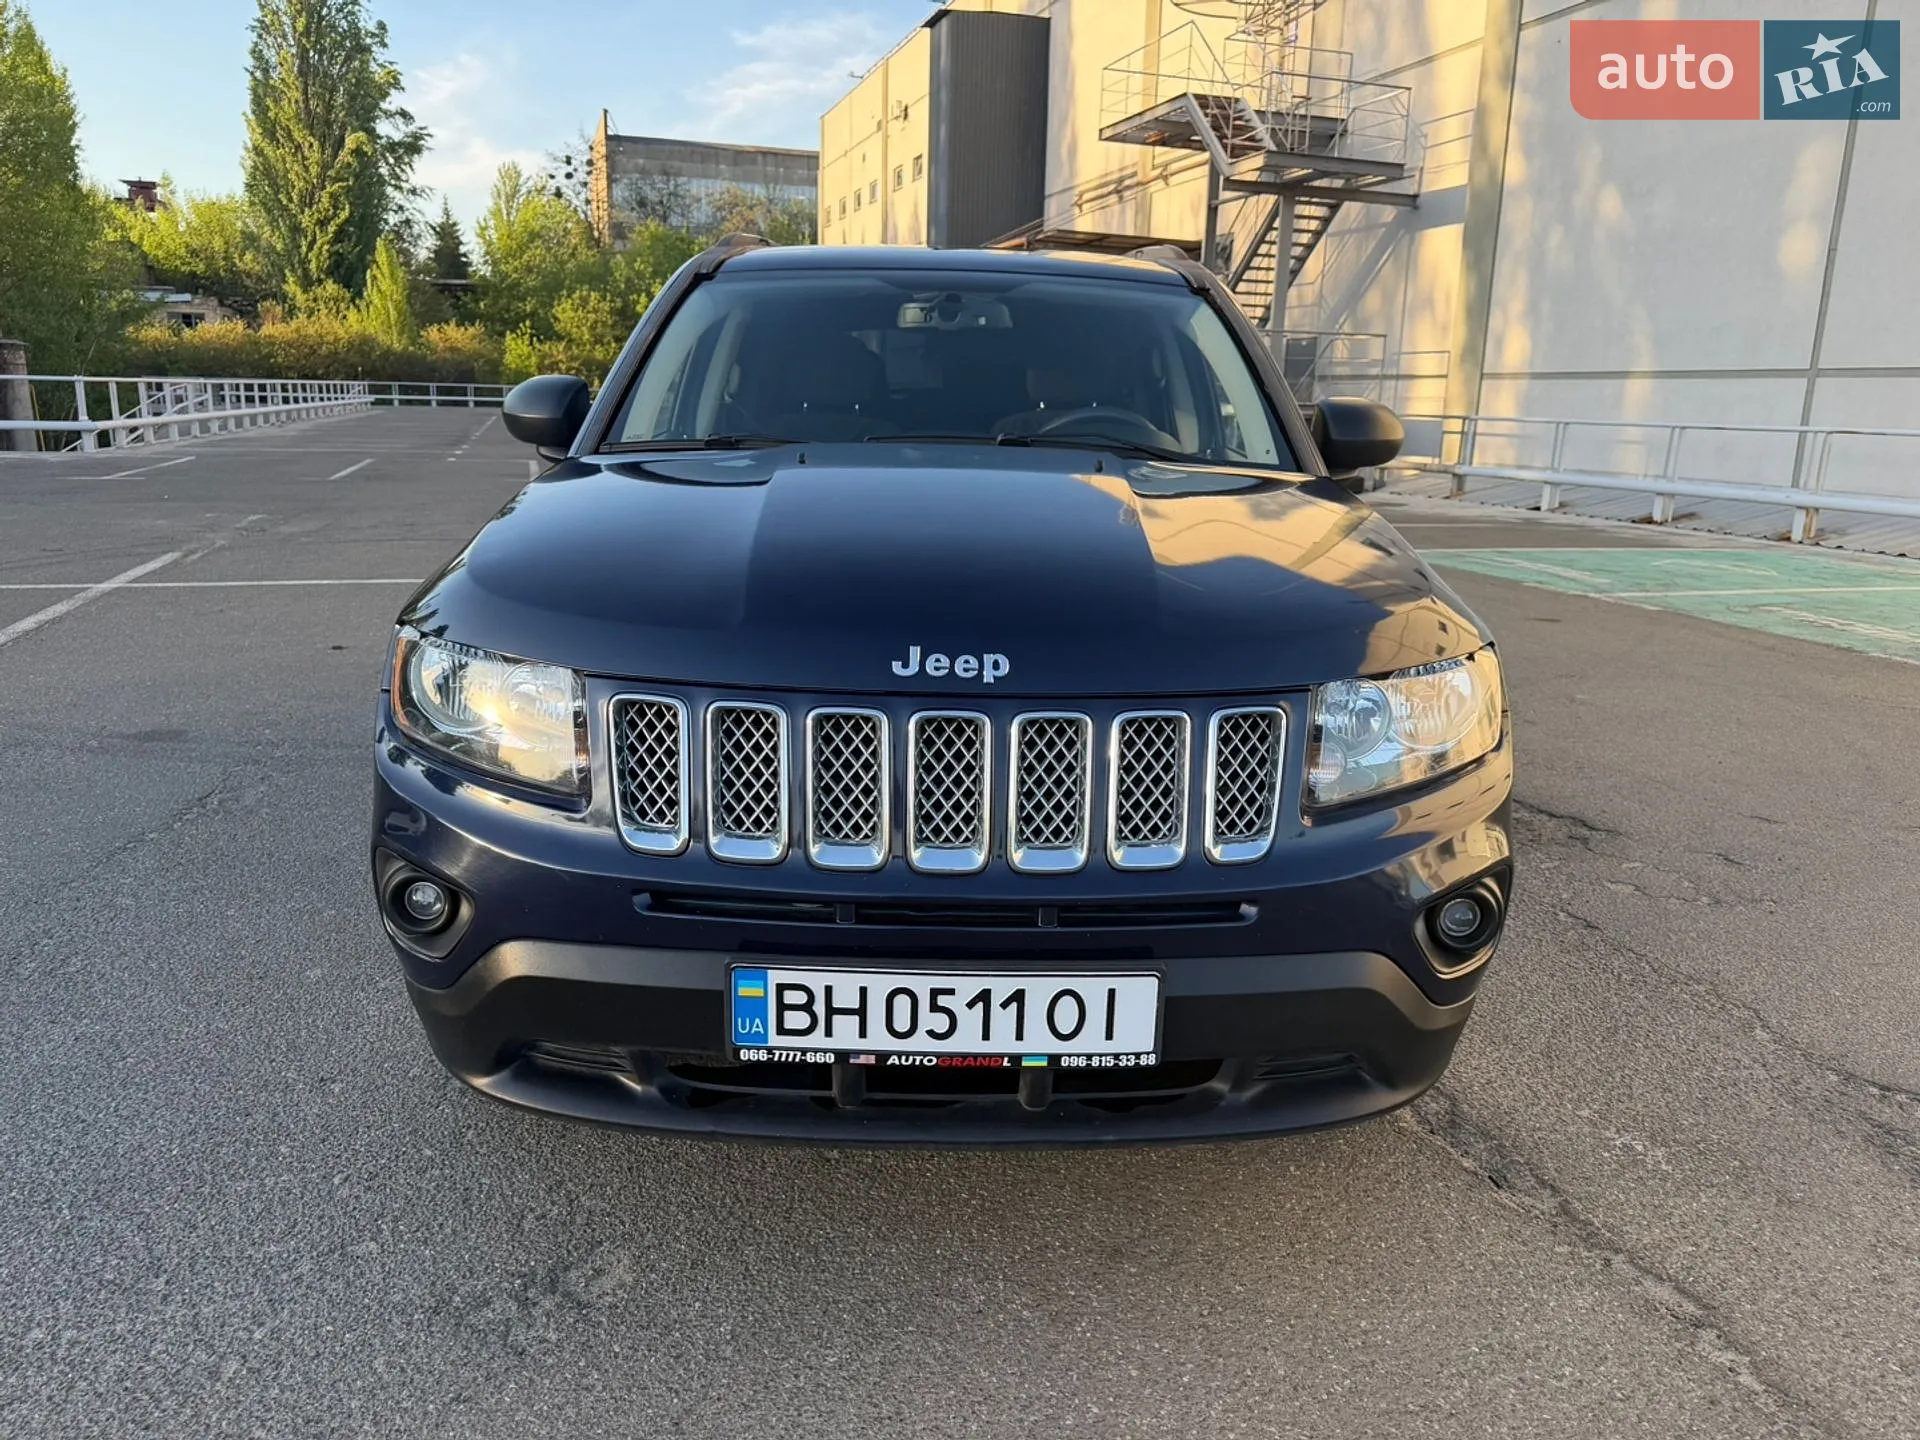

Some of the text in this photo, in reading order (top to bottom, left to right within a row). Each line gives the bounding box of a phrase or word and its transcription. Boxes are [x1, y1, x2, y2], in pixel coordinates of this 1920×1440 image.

[892, 645, 1010, 684] Jeep
[775, 982, 868, 1039] BH
[884, 987, 1026, 1042] 0511
[738, 1017, 765, 1034] UA
[739, 1048, 836, 1064] 066-7777-660
[1060, 1054, 1157, 1068] 096-815-33-88
